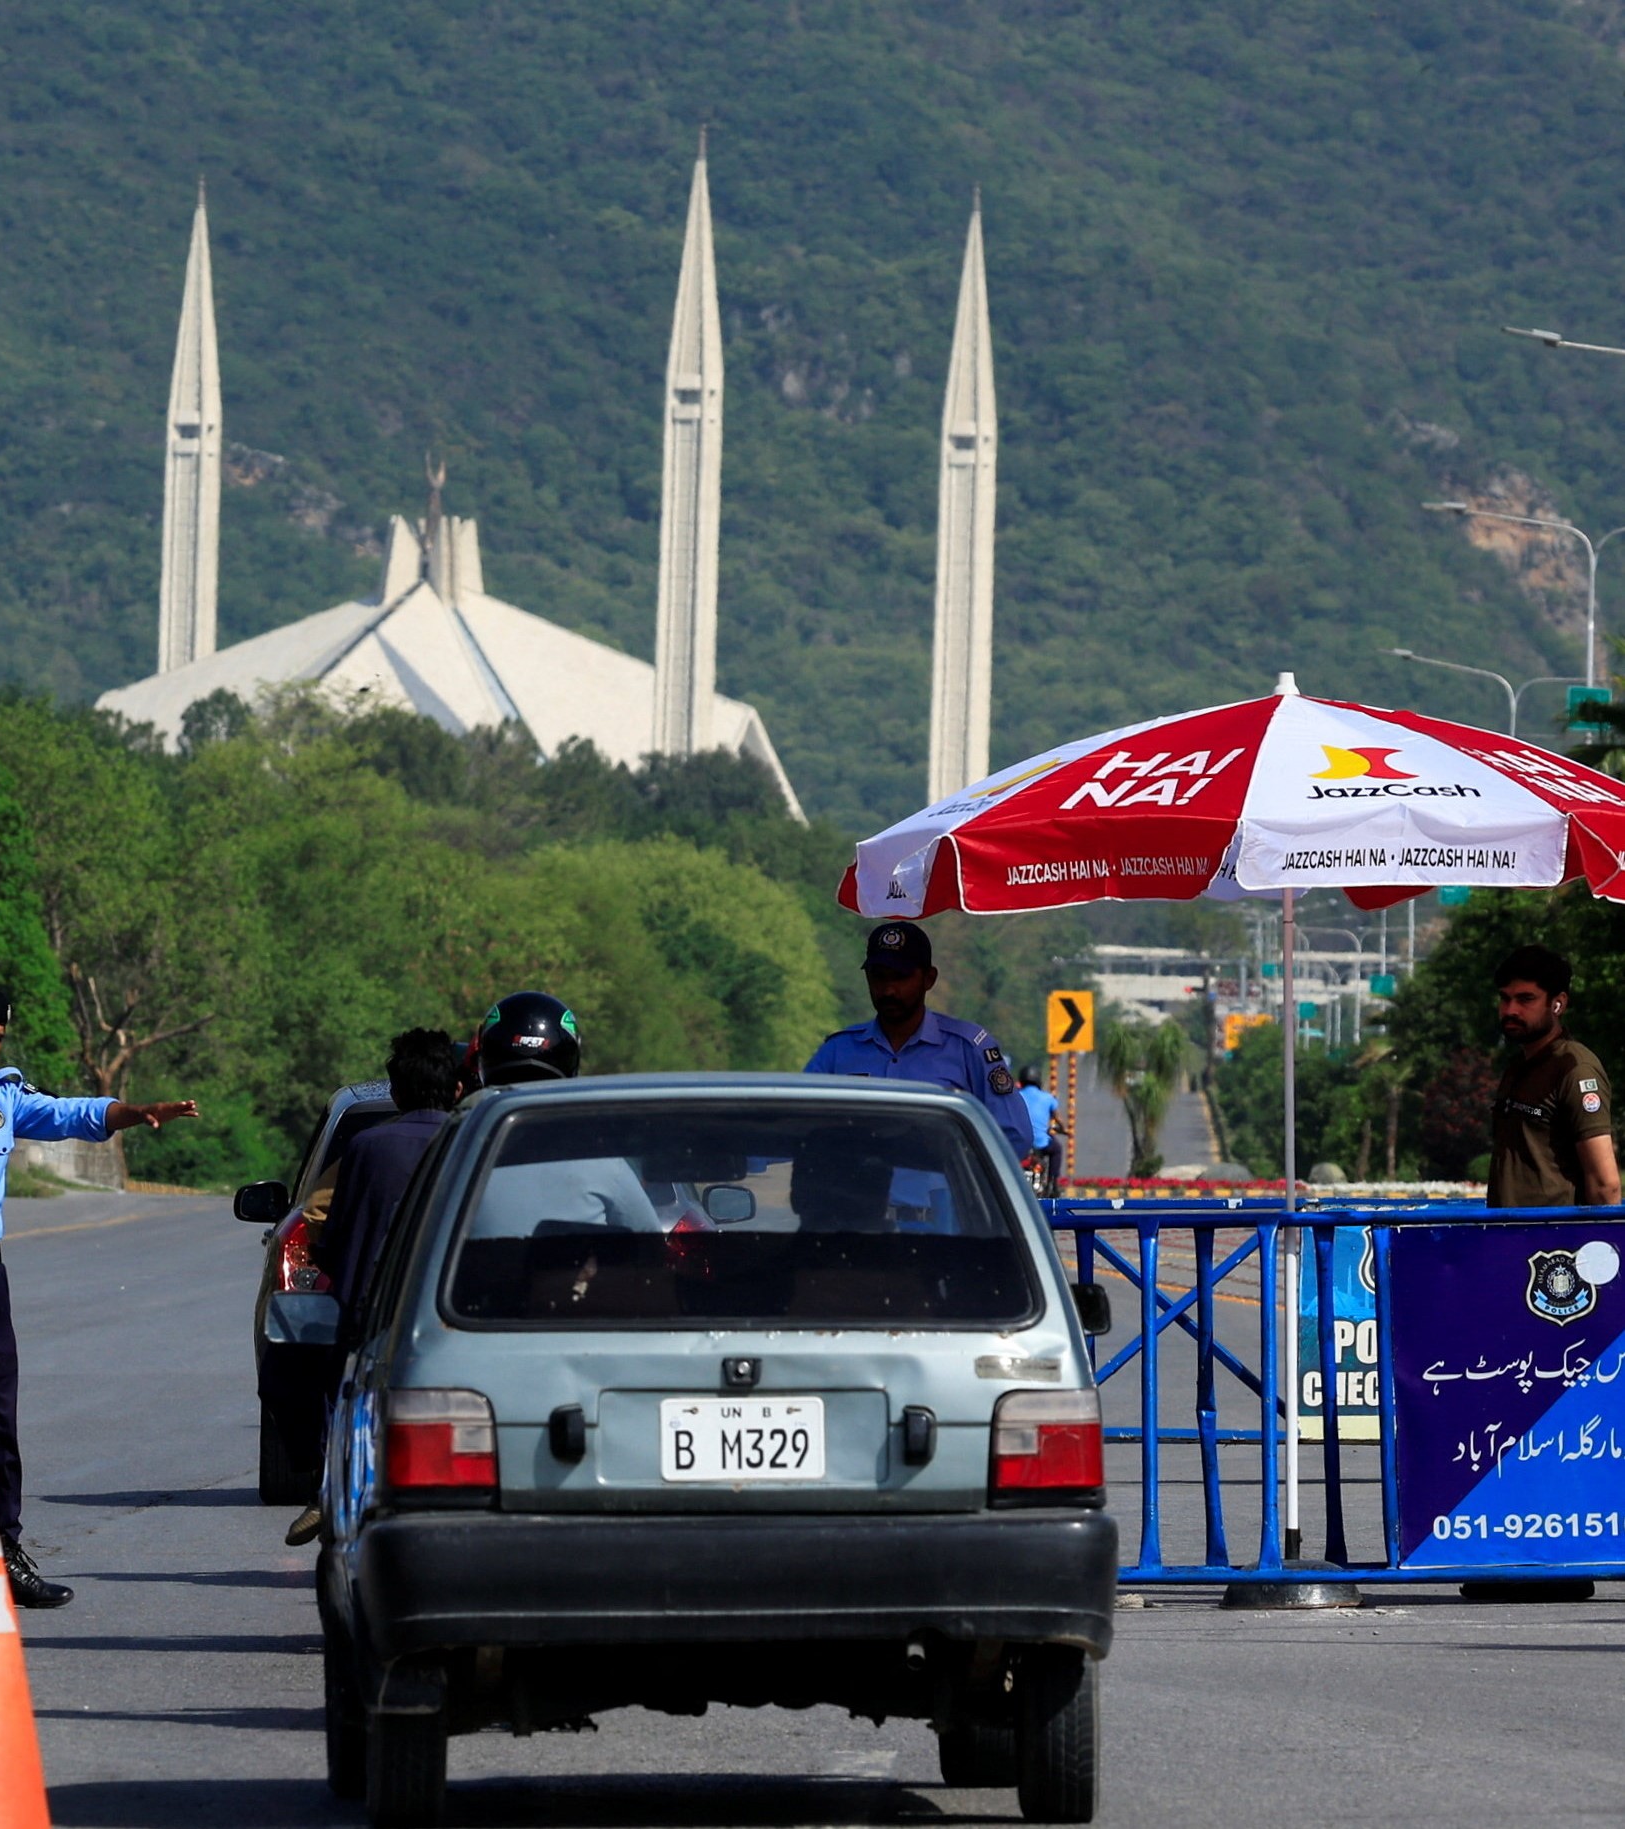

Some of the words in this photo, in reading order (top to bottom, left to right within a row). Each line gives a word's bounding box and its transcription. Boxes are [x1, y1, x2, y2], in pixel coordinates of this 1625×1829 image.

[1092, 747, 1246, 779] HAI
[1059, 778, 1213, 810] NA!
[1306, 784, 1482, 799] JazzCash
[1006, 863, 1068, 886] JAZZCASH
[1070, 860, 1090, 881] HAI
[1093, 858, 1110, 878] NA
[1120, 856, 1175, 876] JAZZCASH
[1177, 856, 1195, 876] HAI
[1282, 851, 1342, 871] JAZZCASH
[1345, 849, 1367, 868] HAI
[1369, 848, 1387, 867] NA
[1399, 848, 1464, 869] JAZZCASH
[1467, 850, 1489, 869] HAI
[1492, 851, 1517, 870] NA!
[1544, 1303, 1579, 1314] POLICE
[1422, 1360, 1463, 1396] ہے
[1466, 1351, 1533, 1394] پوسٹ
[1535, 1339, 1591, 1387] چیک
[675, 1430, 695, 1470] B
[721, 1429, 809, 1469] M329
[1452, 1421, 1502, 1472] آباد
[1497, 1429, 1564, 1479] اسلام
[1433, 1511, 1625, 1540] 051-926151
